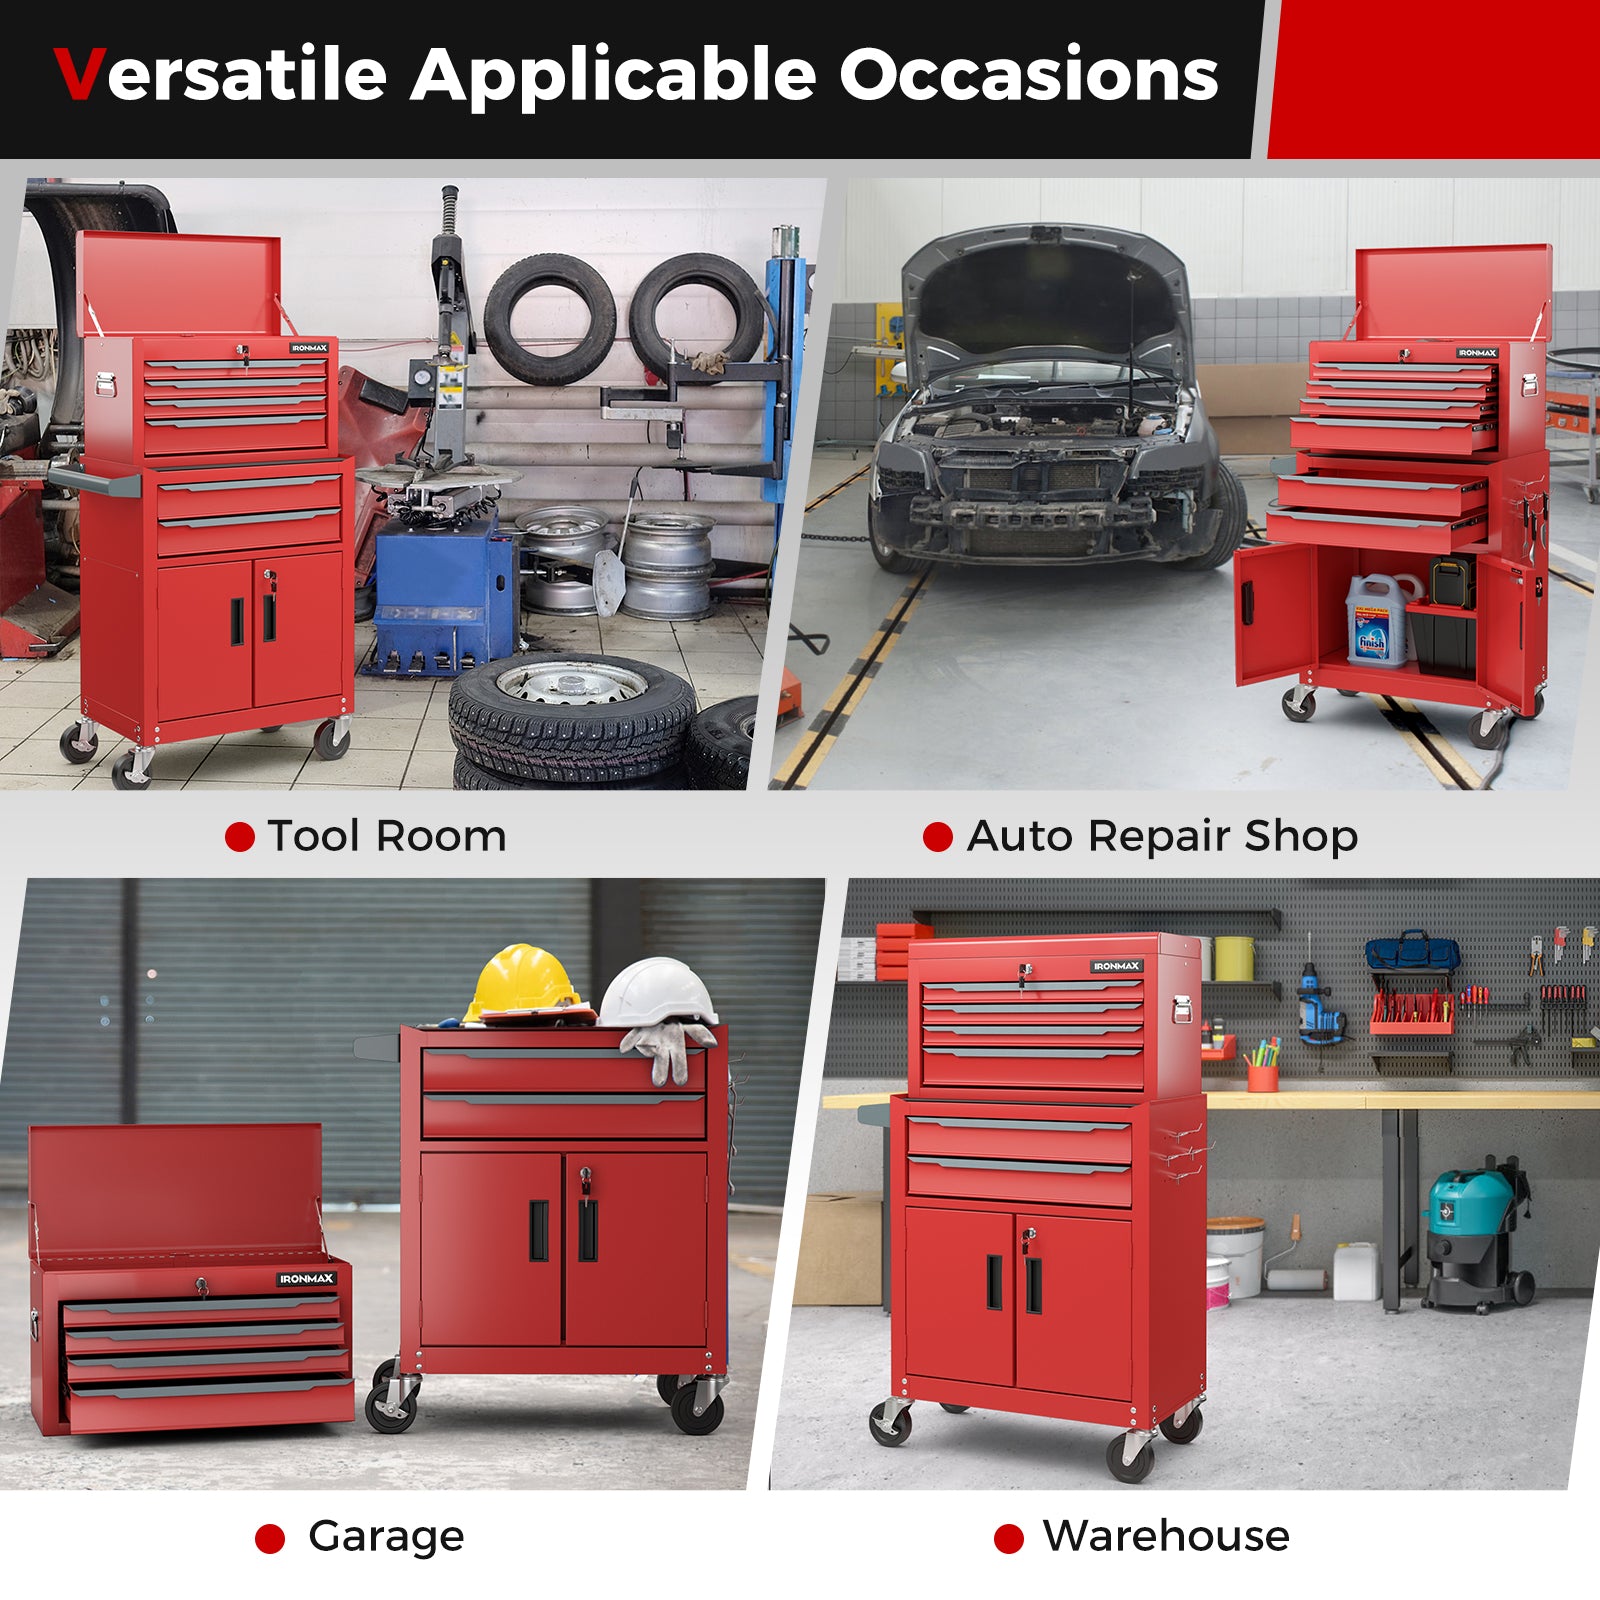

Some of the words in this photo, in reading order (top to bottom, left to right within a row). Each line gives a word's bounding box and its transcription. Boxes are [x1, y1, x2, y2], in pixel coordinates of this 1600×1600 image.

[292, 344, 328, 352] IRONMAX
[1459, 349, 1497, 357] IRONMAX
[1360, 635, 1385, 648] finish
[1094, 961, 1140, 971] IRONMAX
[280, 1273, 334, 1284] IRONMAX
